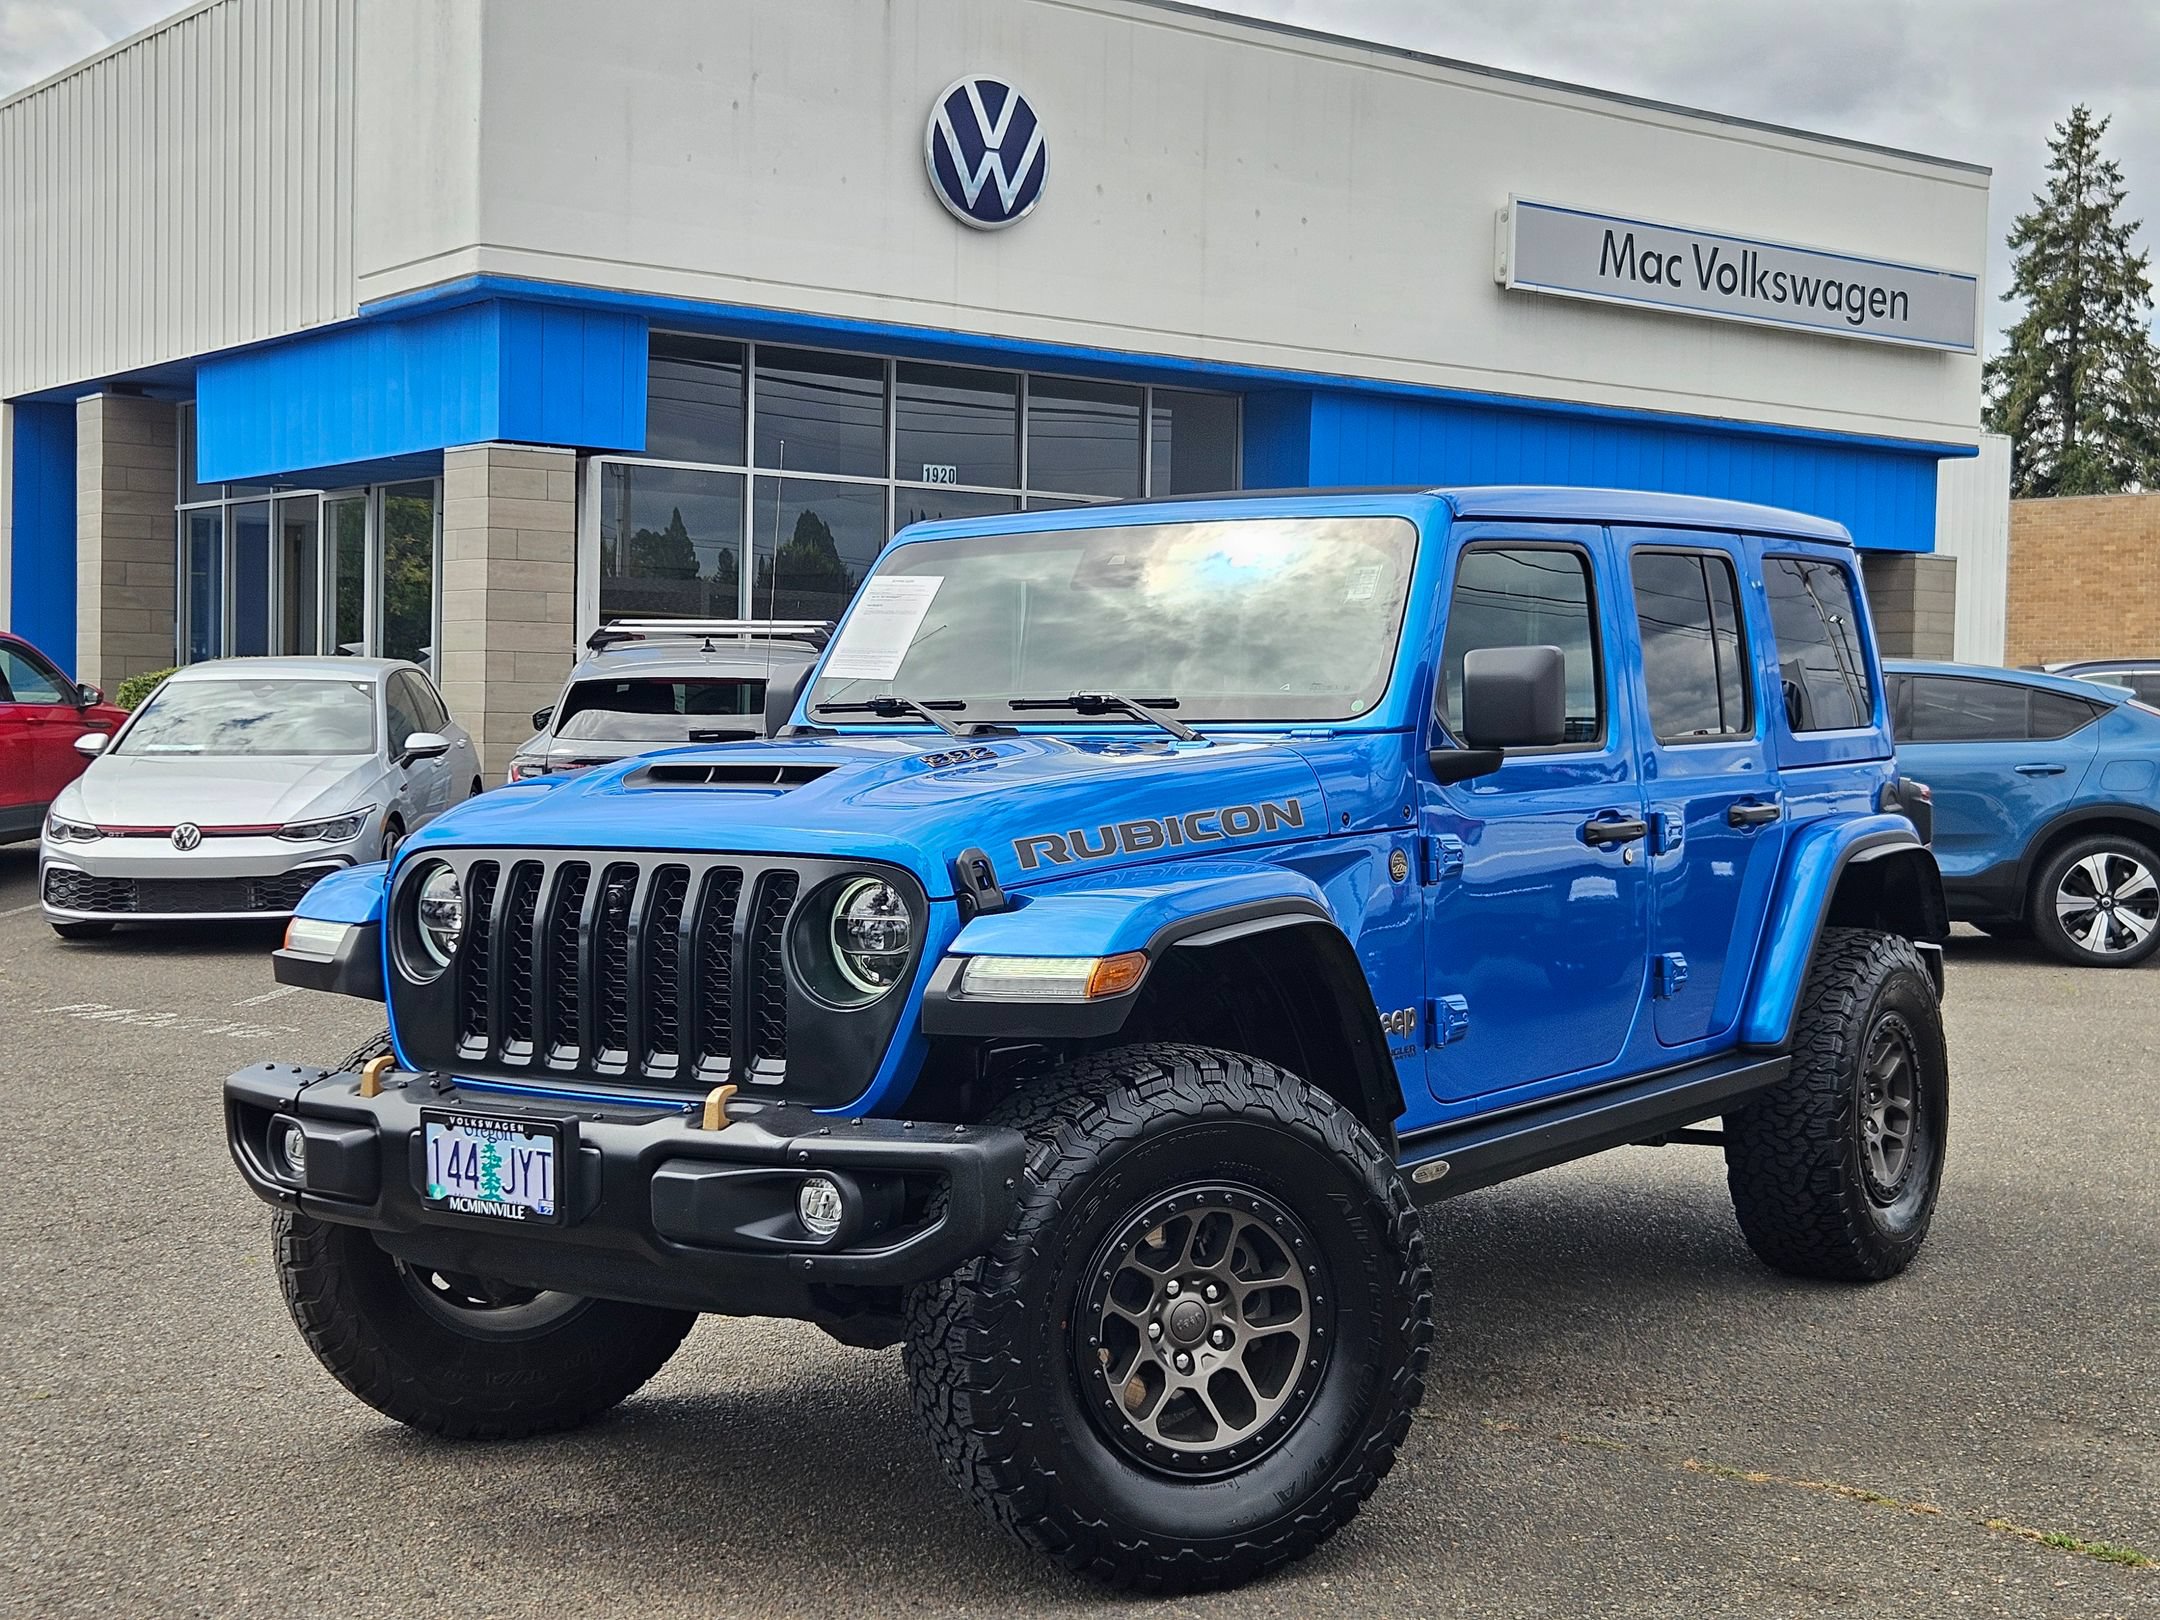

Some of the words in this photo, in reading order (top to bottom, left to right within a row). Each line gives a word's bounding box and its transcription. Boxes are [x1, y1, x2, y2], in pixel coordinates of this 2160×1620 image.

[928, 74, 1050, 229] VW
[1599, 229, 1683, 288] Mac
[1692, 243, 1909, 326] Volkswagen
[925, 467, 955, 484] 1920
[1012, 799, 1304, 870] RUBICON
[1376, 1006, 1416, 1040] eep
[449, 1116, 525, 1132] VOLKSWAGEN
[432, 1136, 479, 1190] 144
[502, 1147, 553, 1199] JYT
[449, 1197, 526, 1220] MCMINNVILLE
